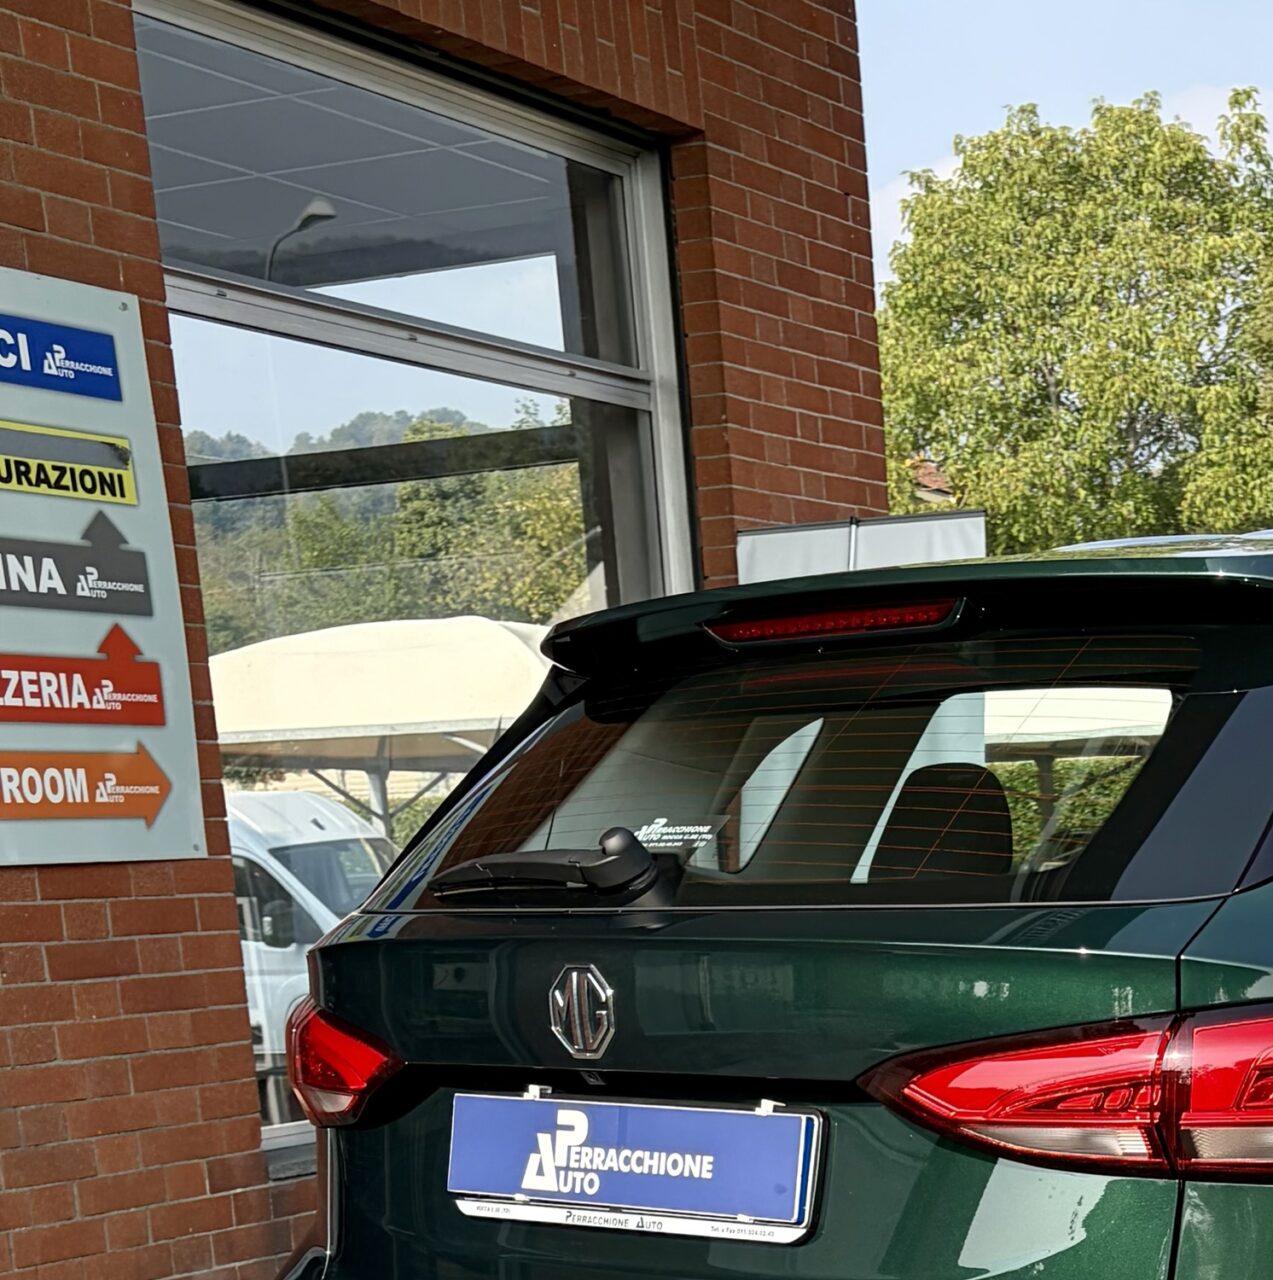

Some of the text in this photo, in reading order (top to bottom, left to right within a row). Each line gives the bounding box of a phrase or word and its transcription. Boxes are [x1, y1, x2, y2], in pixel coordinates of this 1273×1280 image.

[43, 352, 75, 379] AUTO
[0, 459, 126, 498] URAZIONI
[76, 575, 107, 599] AUTO
[0, 669, 91, 709] ZERIA
[92, 688, 121, 710] AUTO
[0, 767, 89, 804] ROOM
[553, 971, 608, 1050] MG
[555, 1109, 714, 1179] PERRACCHIONE
[521, 1133, 600, 1195] AUTO
[565, 1211, 663, 1230] PERRACCHIONE AUTO
